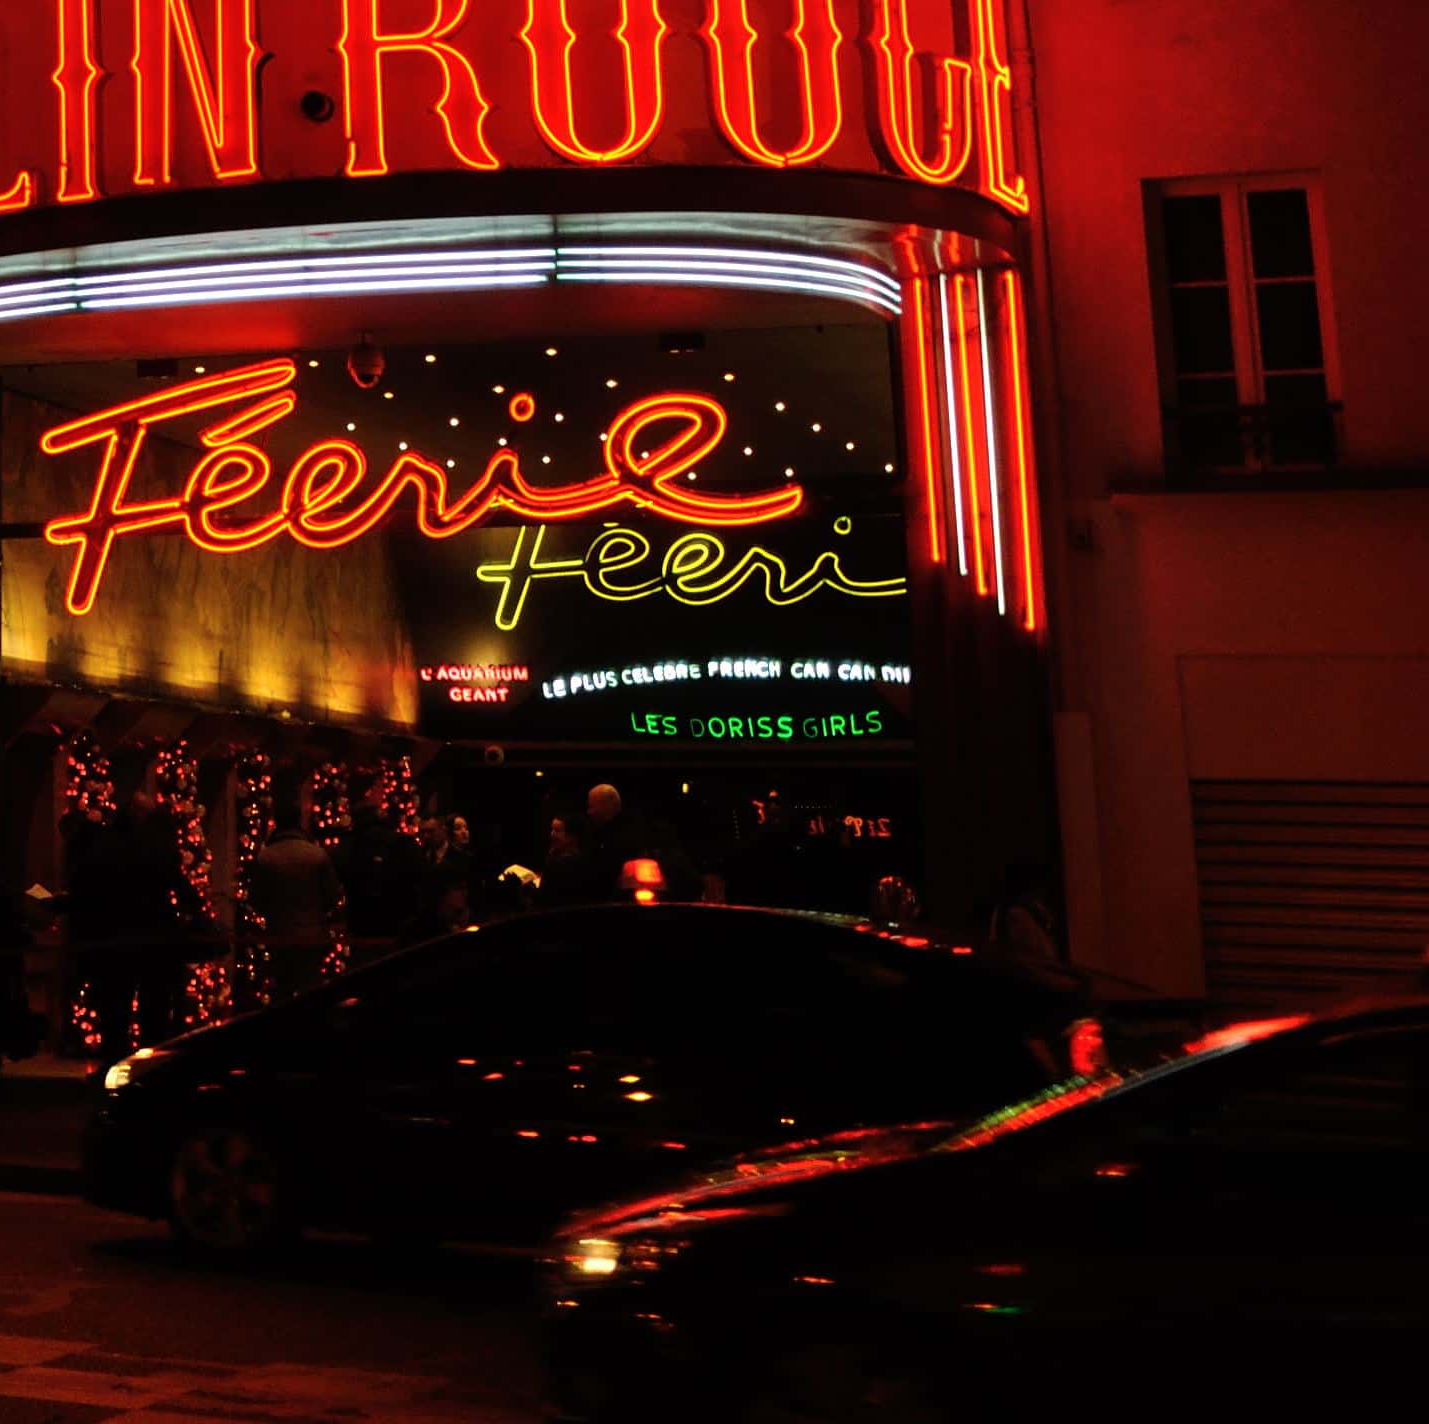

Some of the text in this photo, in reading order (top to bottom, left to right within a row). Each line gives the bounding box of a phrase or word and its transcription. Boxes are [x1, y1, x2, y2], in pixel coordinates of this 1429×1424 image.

[41, 357, 802, 615] Féerie
[449, 687, 509, 703] GEANT
[542, 678, 566, 698] LE
[571, 670, 618, 694] PLUS
[791, 660, 831, 680] CAN
[838, 662, 876, 682] CAN
[631, 710, 883, 739] LES DORISS GIRLS
